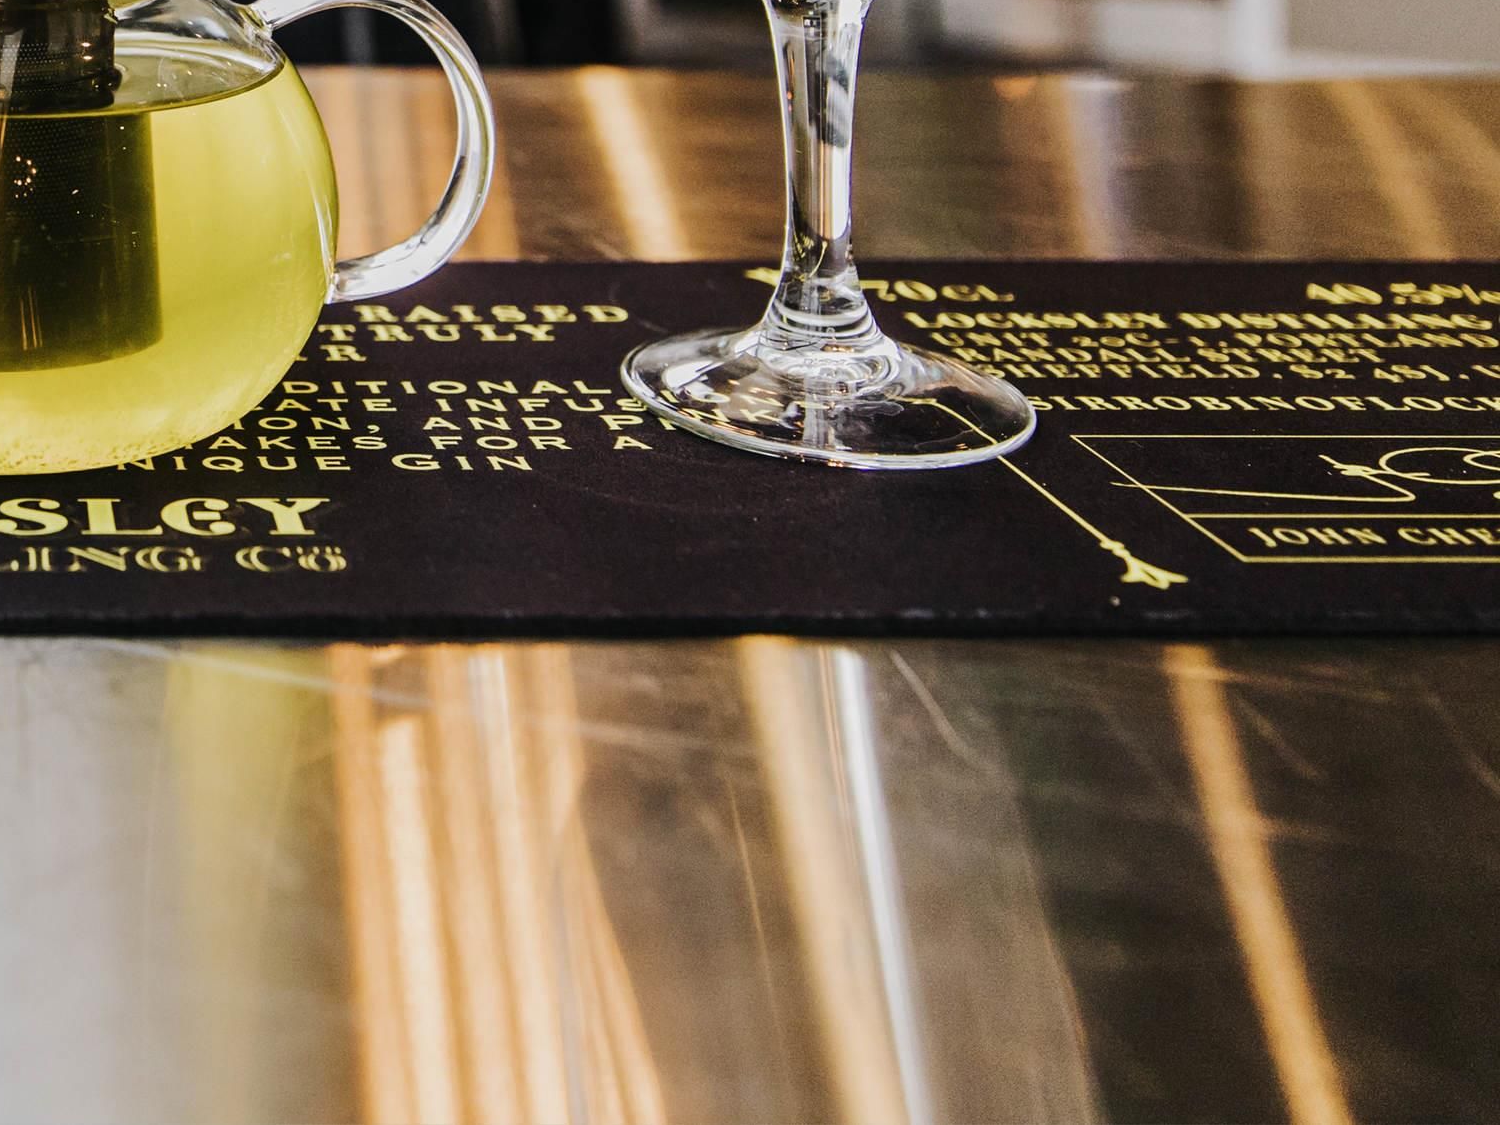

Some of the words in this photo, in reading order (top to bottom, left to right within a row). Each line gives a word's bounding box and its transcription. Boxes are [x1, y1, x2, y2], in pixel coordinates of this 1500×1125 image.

[353, 305, 629, 323] RAISED
[318, 323, 555, 342] TRULY
[931, 332, 1052, 347] UNIT
[952, 347, 1191, 363] RANDALL
[1197, 347, 1385, 363] STREET
[283, 380, 612, 395] DITIONAL
[422, 416, 563, 431] AND
[184, 435, 388, 450] AKES
[429, 435, 573, 451] FOR
[612, 435, 653, 451] A
[117, 455, 351, 472] NIQUE
[390, 453, 533, 472] GIN
[1247, 527, 1388, 548] JOHN
